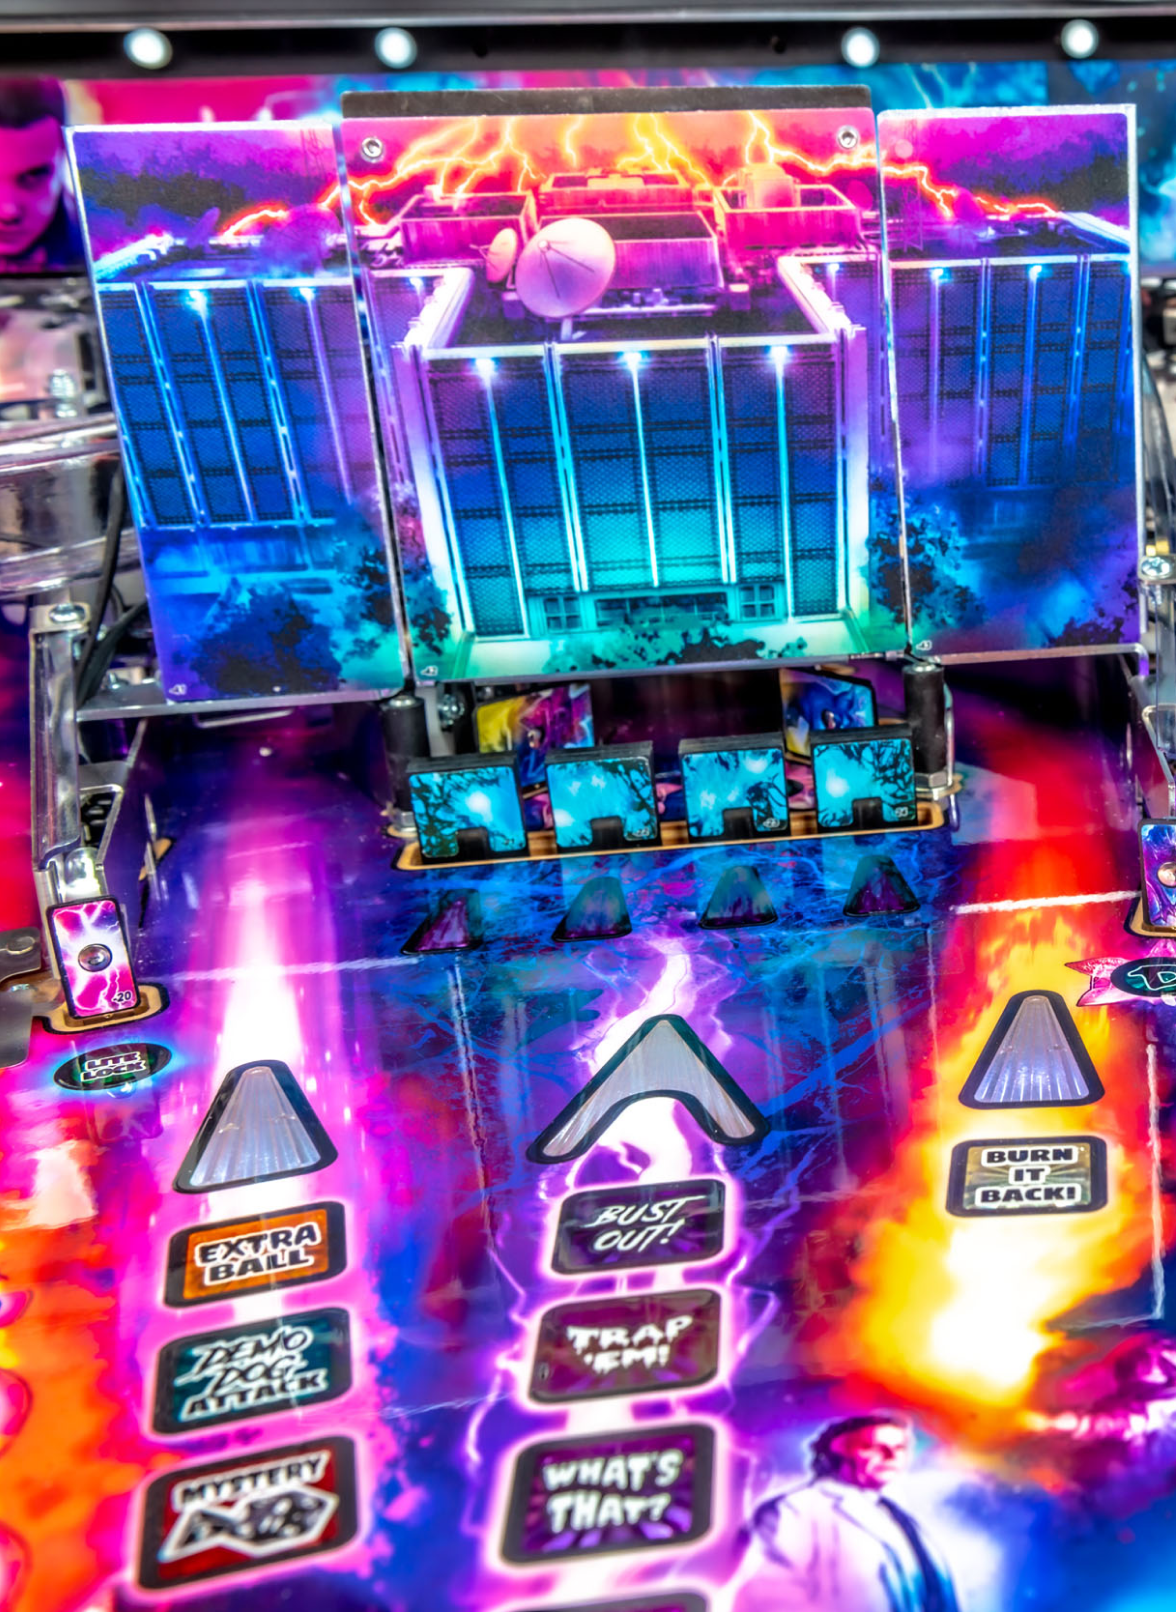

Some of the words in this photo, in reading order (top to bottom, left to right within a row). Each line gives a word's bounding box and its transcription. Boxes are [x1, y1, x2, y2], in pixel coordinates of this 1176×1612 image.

[112, 990, 132, 1003] -20
[81, 1060, 147, 1081] LOCK
[85, 1052, 141, 1071] LITE
[984, 1147, 1075, 1165] BURN
[1012, 1167, 1046, 1183] IT
[979, 1185, 1077, 1203] BACK!
[581, 1195, 706, 1228] BUST
[198, 1223, 319, 1264] EXTRA
[593, 1218, 686, 1252] OUT!
[207, 1248, 312, 1283] BALL
[190, 1326, 314, 1376] DEMO
[566, 1315, 693, 1355] TRAP
[184, 1369, 327, 1419] ATTACK
[176, 1453, 327, 1506] MYSTERY
[542, 1448, 684, 1492] WHAT'S
[546, 1489, 672, 1534] THAT?
